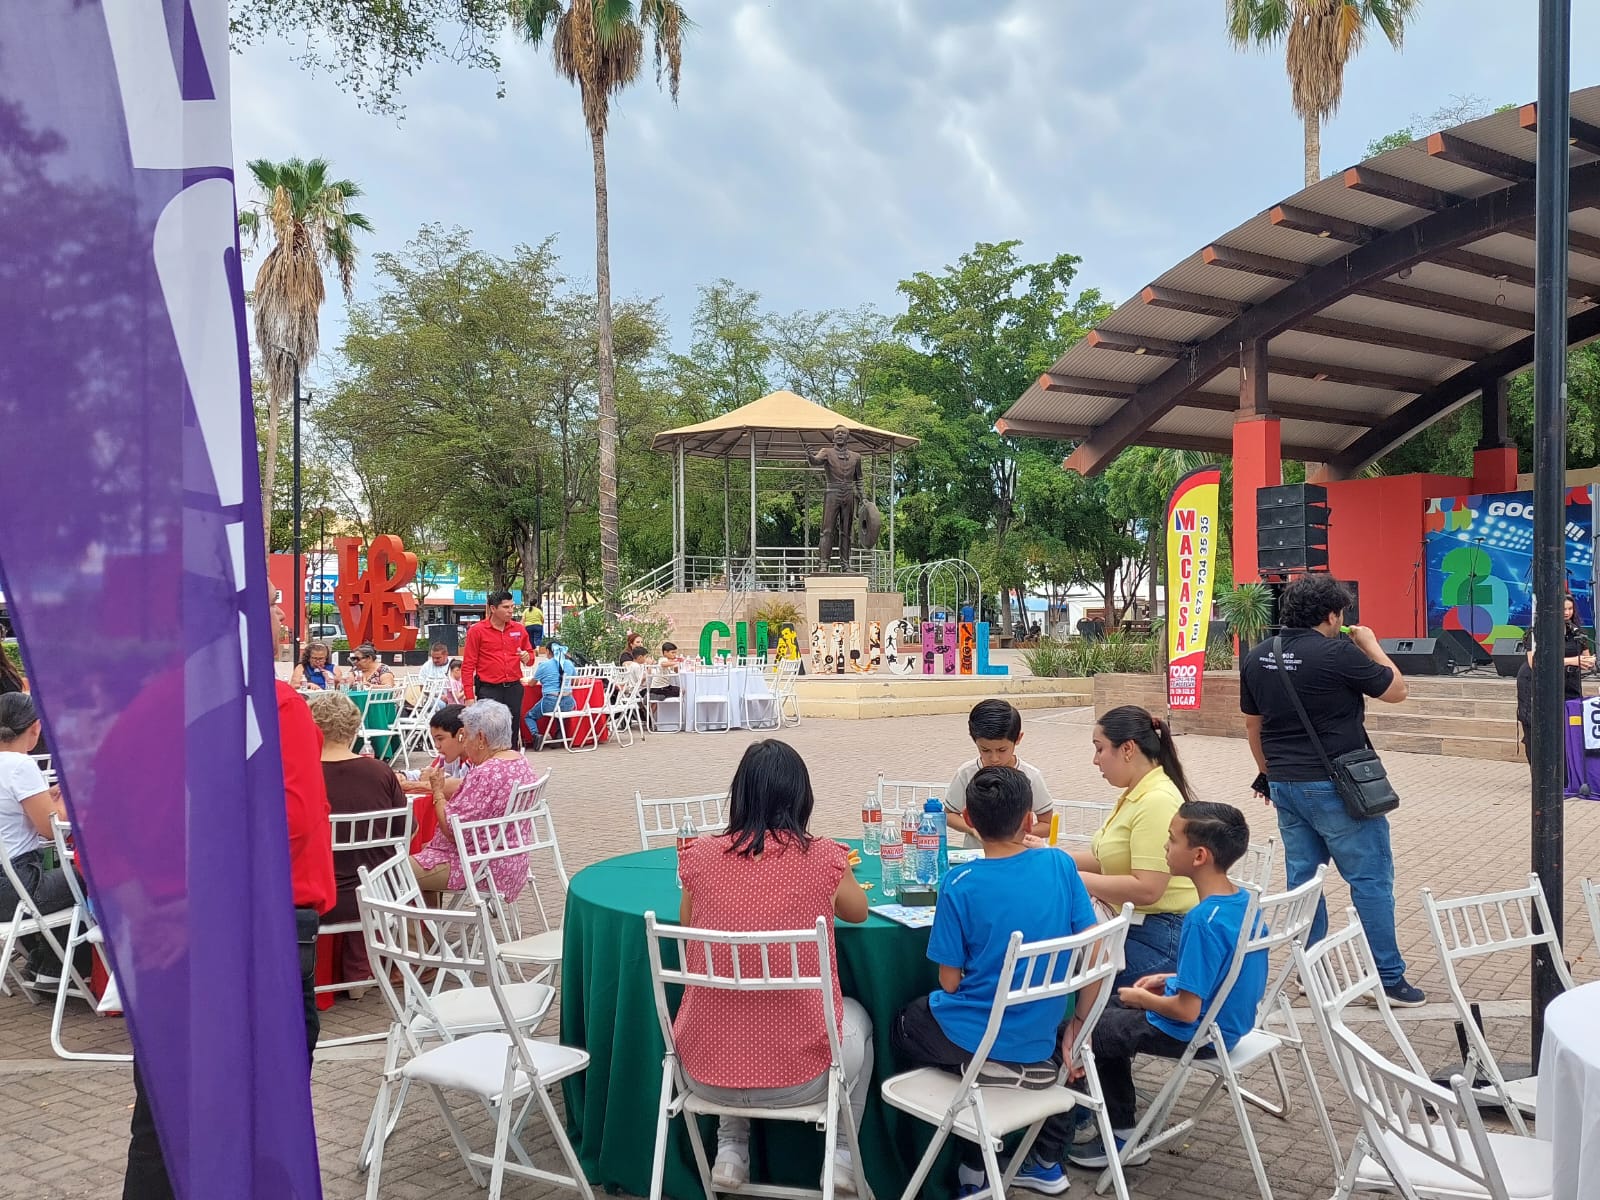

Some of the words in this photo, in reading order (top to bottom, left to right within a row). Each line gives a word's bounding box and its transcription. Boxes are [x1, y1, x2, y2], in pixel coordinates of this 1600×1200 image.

[1200, 516, 1209, 533] 35
[1175, 509, 1196, 652] MACASA
[1198, 559, 1207, 585] 734
[1195, 590, 1203, 615] 673
[1170, 665, 1197, 677] TODO
[1170, 695, 1196, 706] LUGAR
